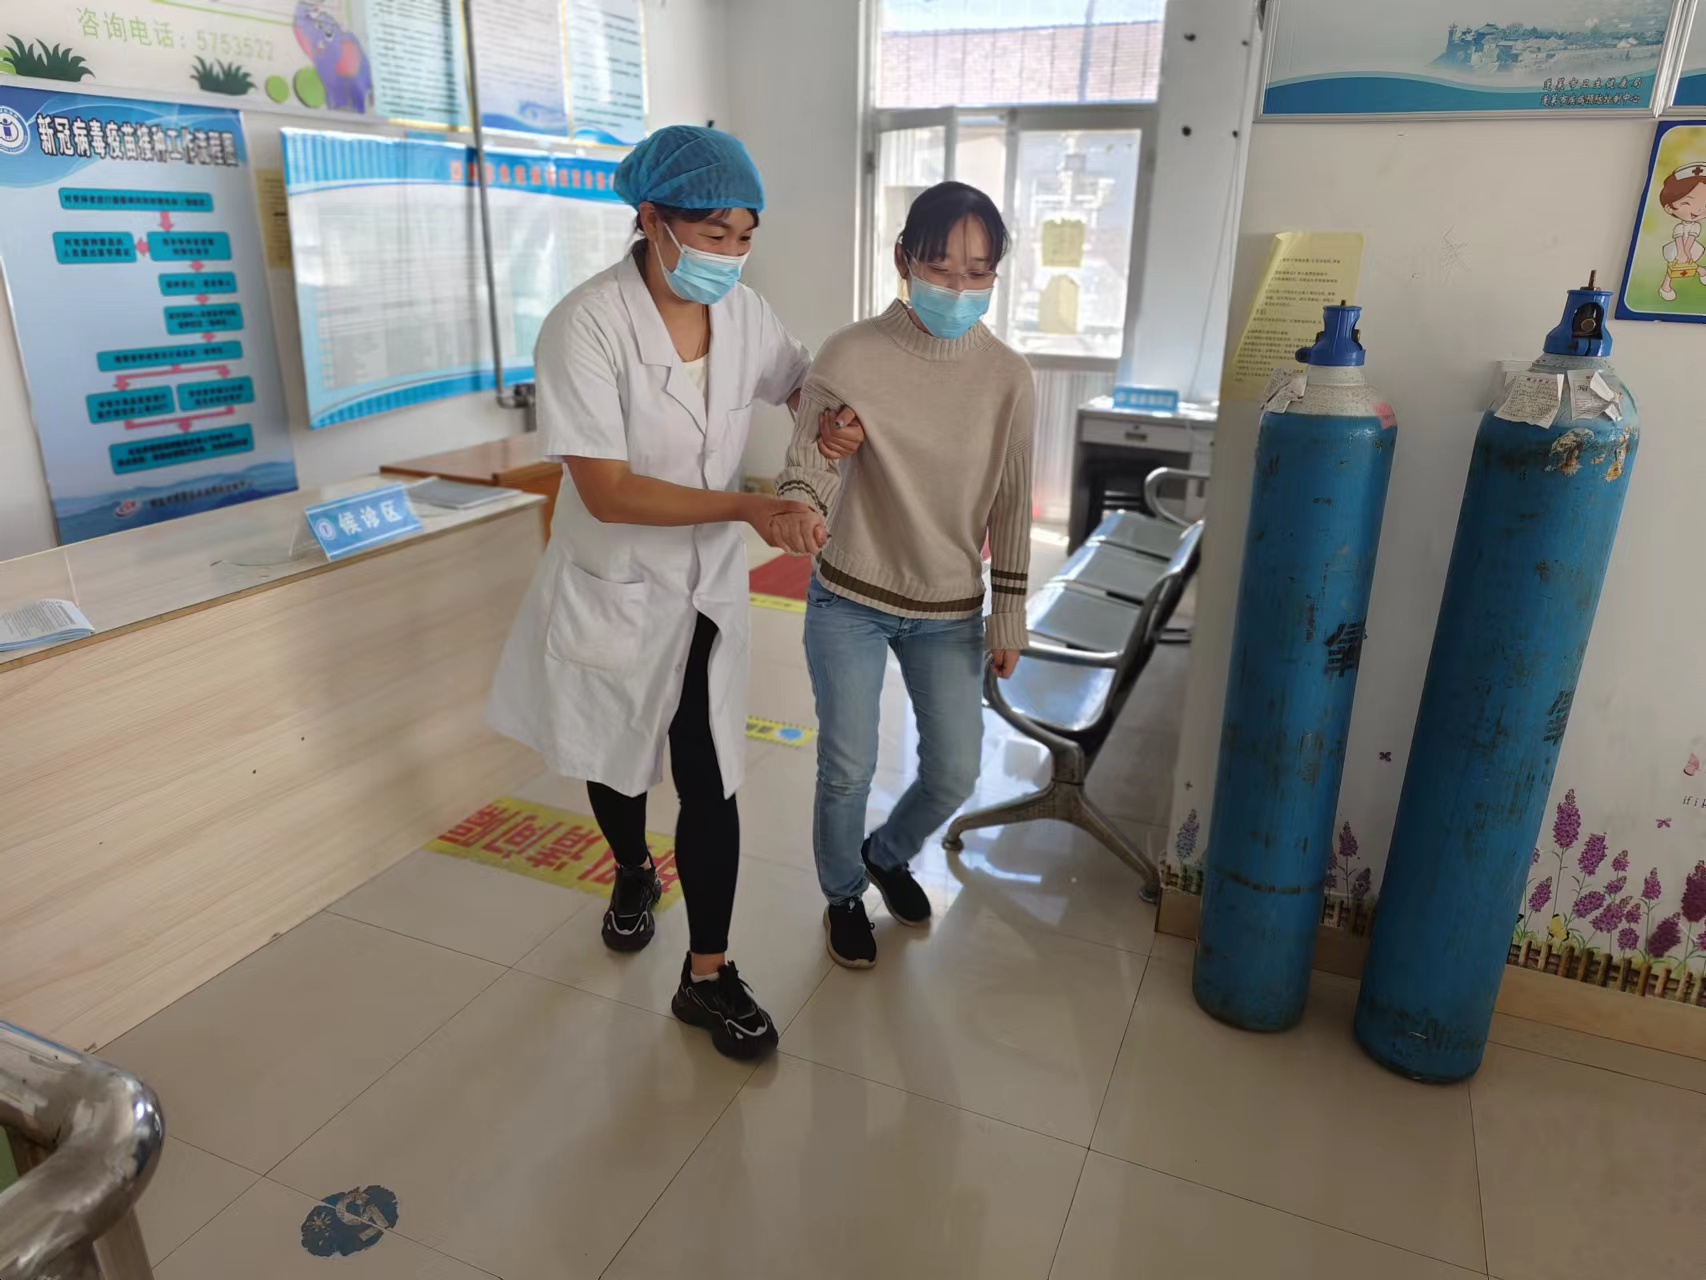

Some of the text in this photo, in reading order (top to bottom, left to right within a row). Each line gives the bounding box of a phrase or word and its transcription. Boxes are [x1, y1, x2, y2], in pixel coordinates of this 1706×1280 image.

[36, 114, 240, 167] 新冠病毒疫苗接种工作流程图
[338, 499, 404, 536] 候诊区
